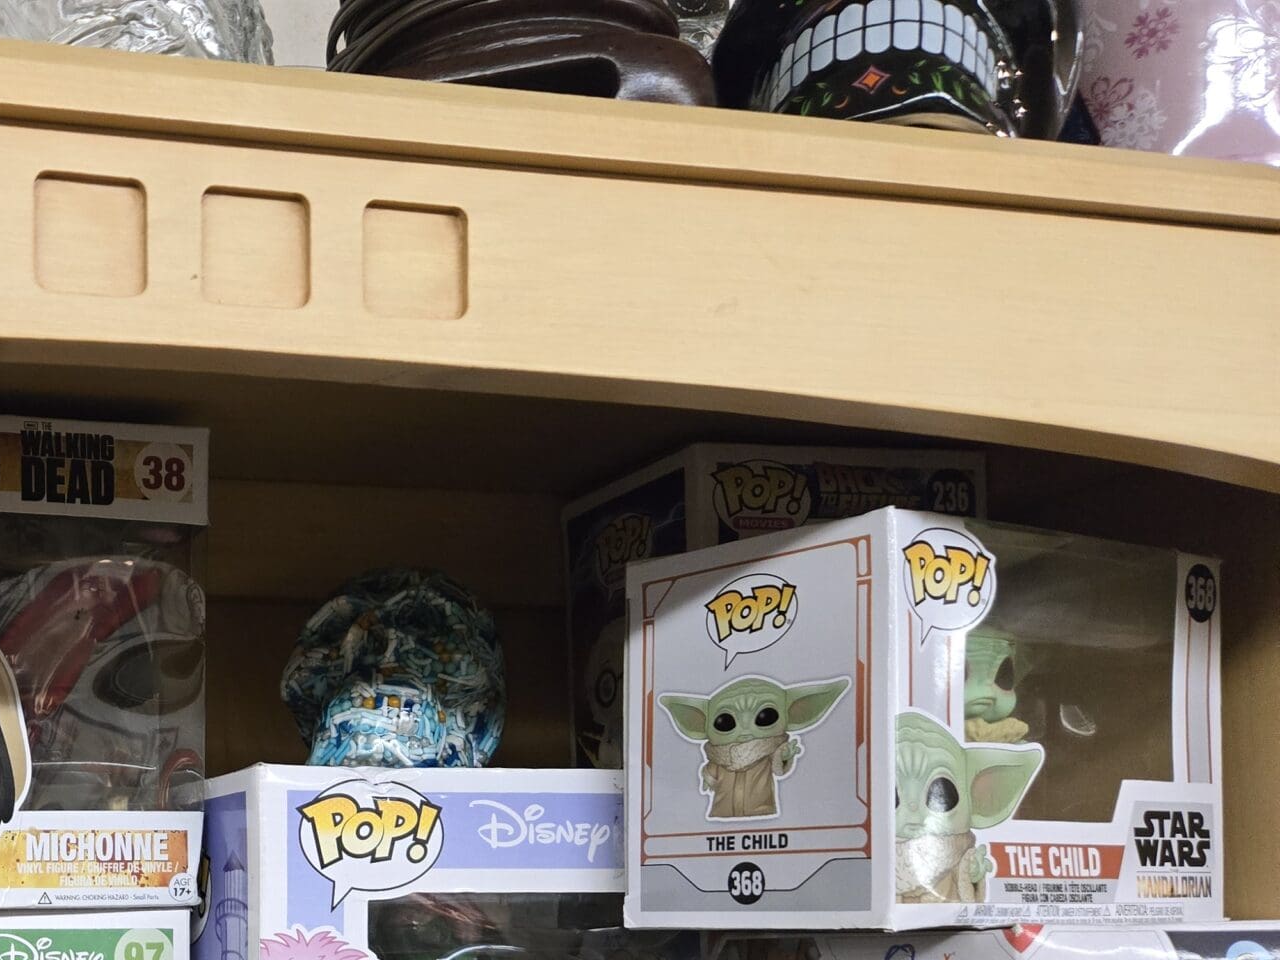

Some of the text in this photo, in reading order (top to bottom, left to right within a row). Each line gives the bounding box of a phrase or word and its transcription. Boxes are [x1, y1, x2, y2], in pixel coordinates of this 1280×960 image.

[20, 430, 115, 462] WALKING
[20, 456, 115, 506] DEAD
[141, 455, 186, 492] 38
[712, 463, 809, 517] POP!
[932, 480, 970, 514] 236
[902, 540, 992, 607] POP!
[1187, 575, 1214, 612] 368
[705, 584, 796, 641] POP!
[296, 793, 443, 870] POP!
[468, 799, 611, 863] Disney
[1133, 810, 1211, 839] STAR
[25, 830, 170, 863] MICHONNE
[706, 833, 789, 852] THE CHILD
[1134, 838, 1211, 869] WARS
[47, 862, 79, 874] FIGURE
[128, 862, 140, 874] DE
[1004, 845, 1102, 878] THE CHILD
[172, 888, 192, 900] 17+
[731, 870, 763, 897] 368
[1136, 875, 1212, 898] MANDALORIAN
